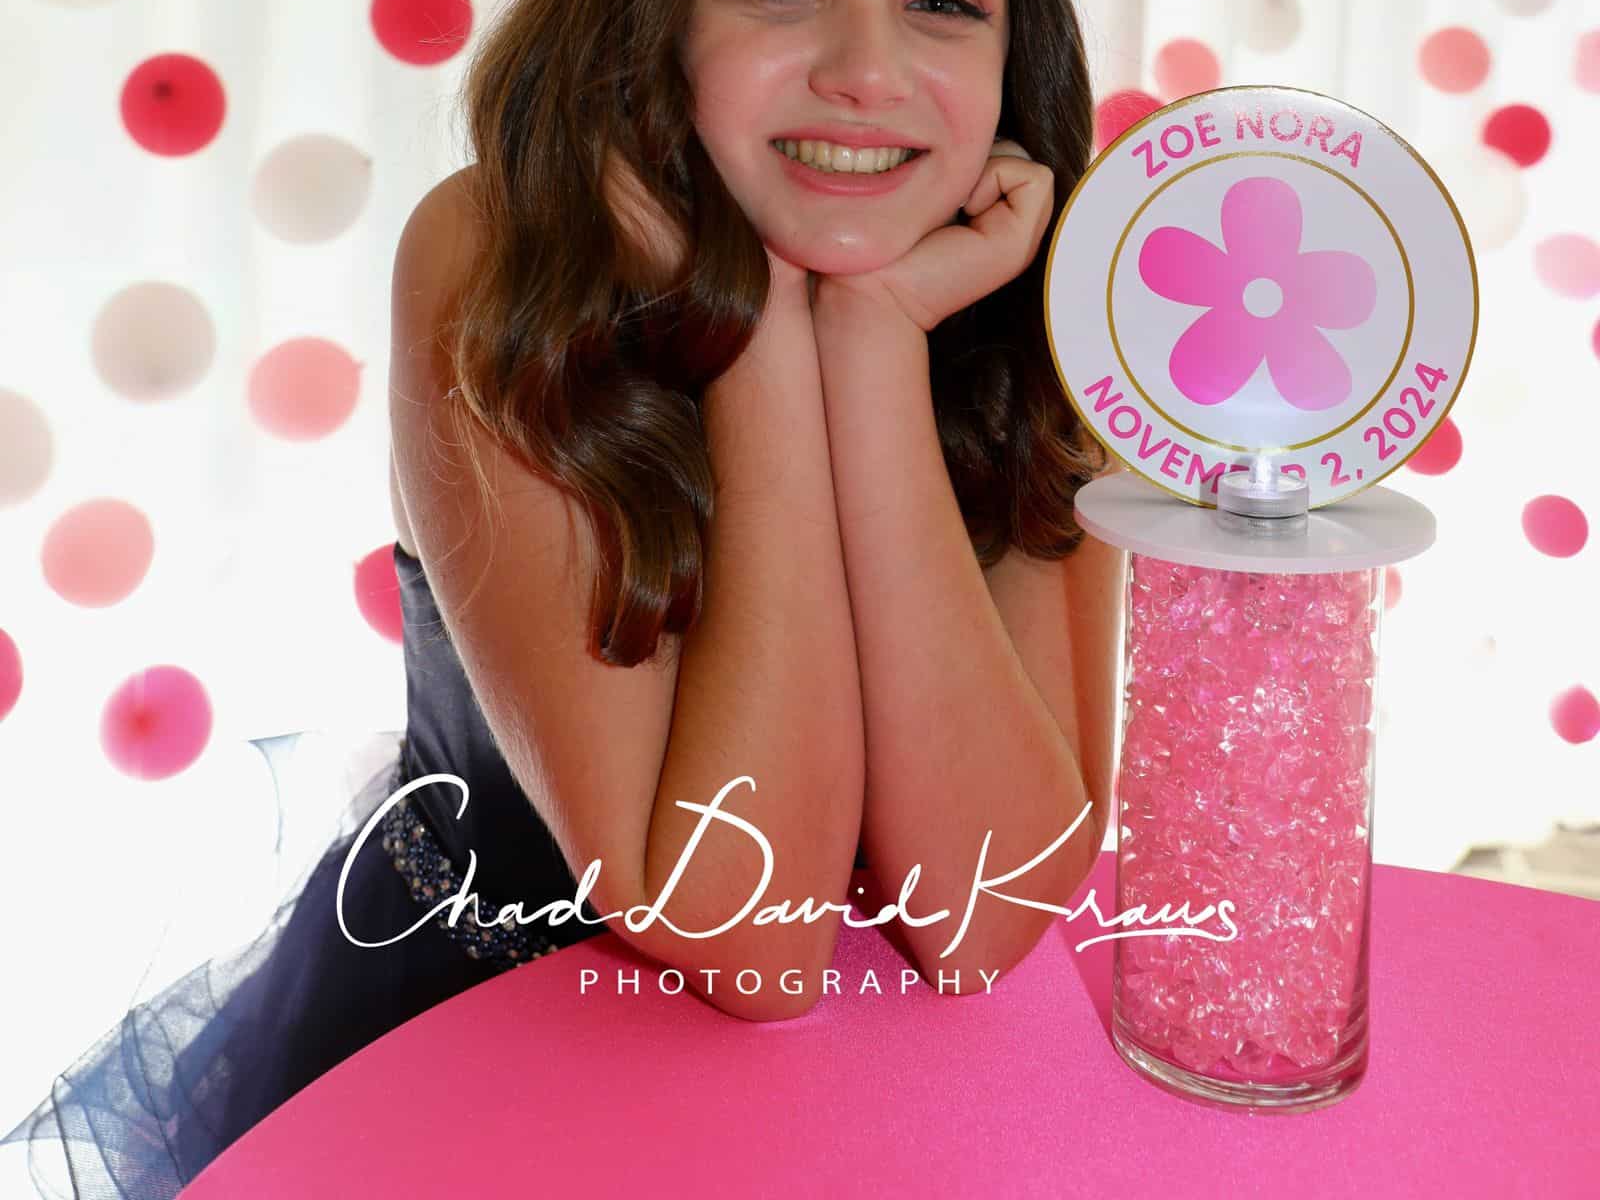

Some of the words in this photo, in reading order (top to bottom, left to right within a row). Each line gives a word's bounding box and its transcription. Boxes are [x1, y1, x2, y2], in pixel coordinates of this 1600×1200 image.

[1131, 111, 1222, 179] ZOE
[1234, 106, 1364, 169] NORA
[1083, 375, 1306, 494] NOVEM
[1320, 452, 1364, 487] 2,
[1363, 361, 1450, 461] 2024
